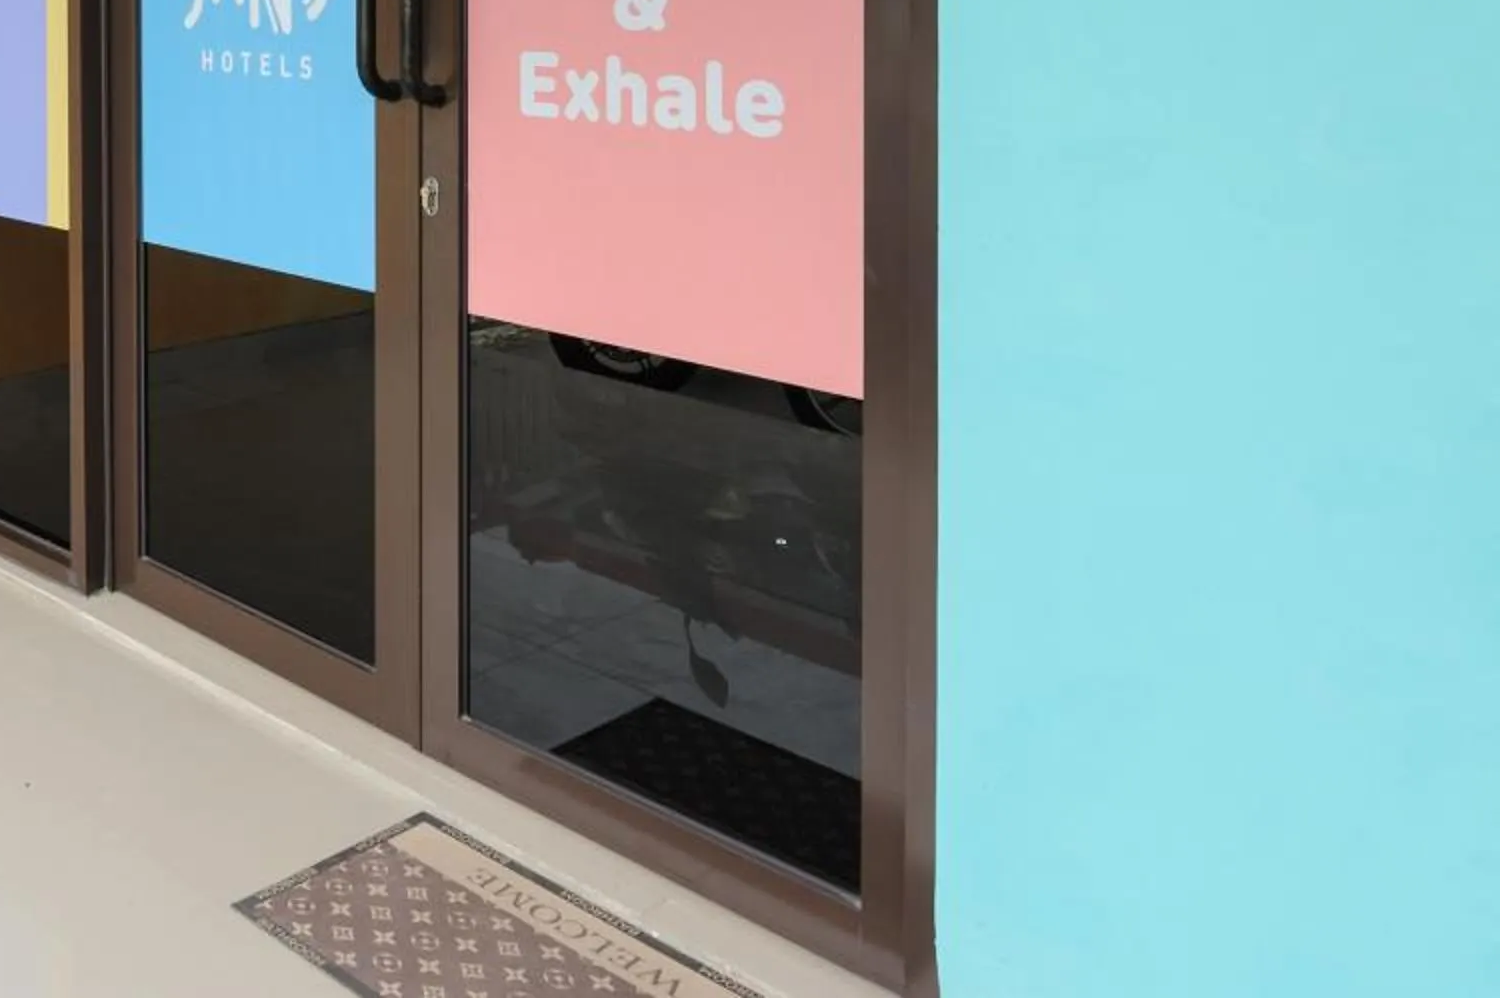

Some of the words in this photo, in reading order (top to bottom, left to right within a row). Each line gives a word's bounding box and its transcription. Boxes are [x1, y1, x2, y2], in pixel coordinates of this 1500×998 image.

[201, 49, 313, 80] HOTELS
[519, 51, 785, 138] Exhale
[467, 867, 681, 996] WELCOME
